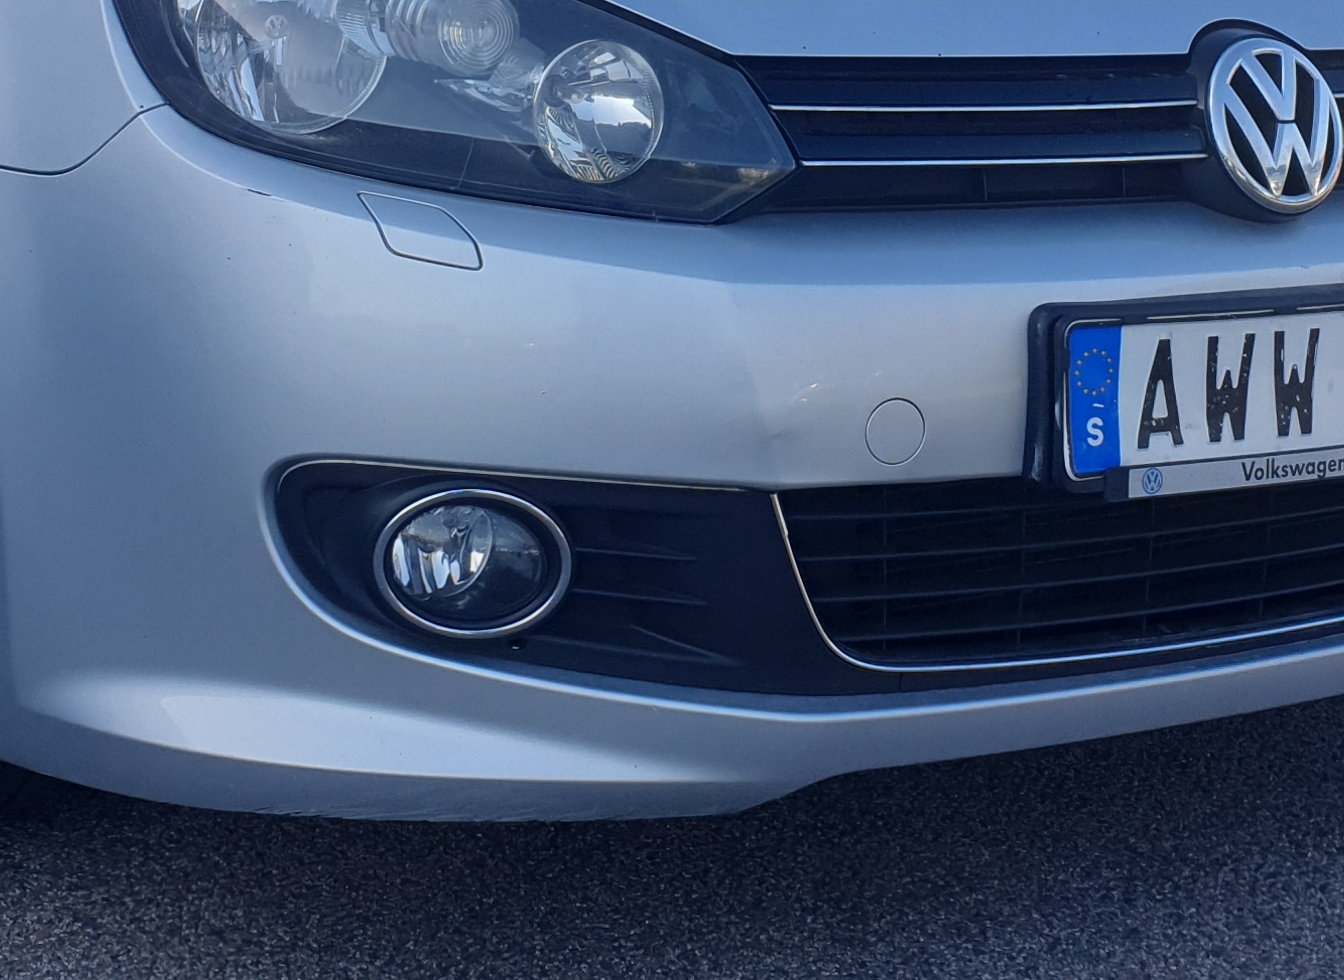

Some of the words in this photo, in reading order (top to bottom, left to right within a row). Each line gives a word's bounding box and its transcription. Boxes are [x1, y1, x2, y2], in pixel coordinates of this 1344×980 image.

[1210, 38, 1344, 214] VW
[1138, 327, 1320, 450] AWW
[1087, 418, 1104, 447] S
[1142, 468, 1164, 495] VW
